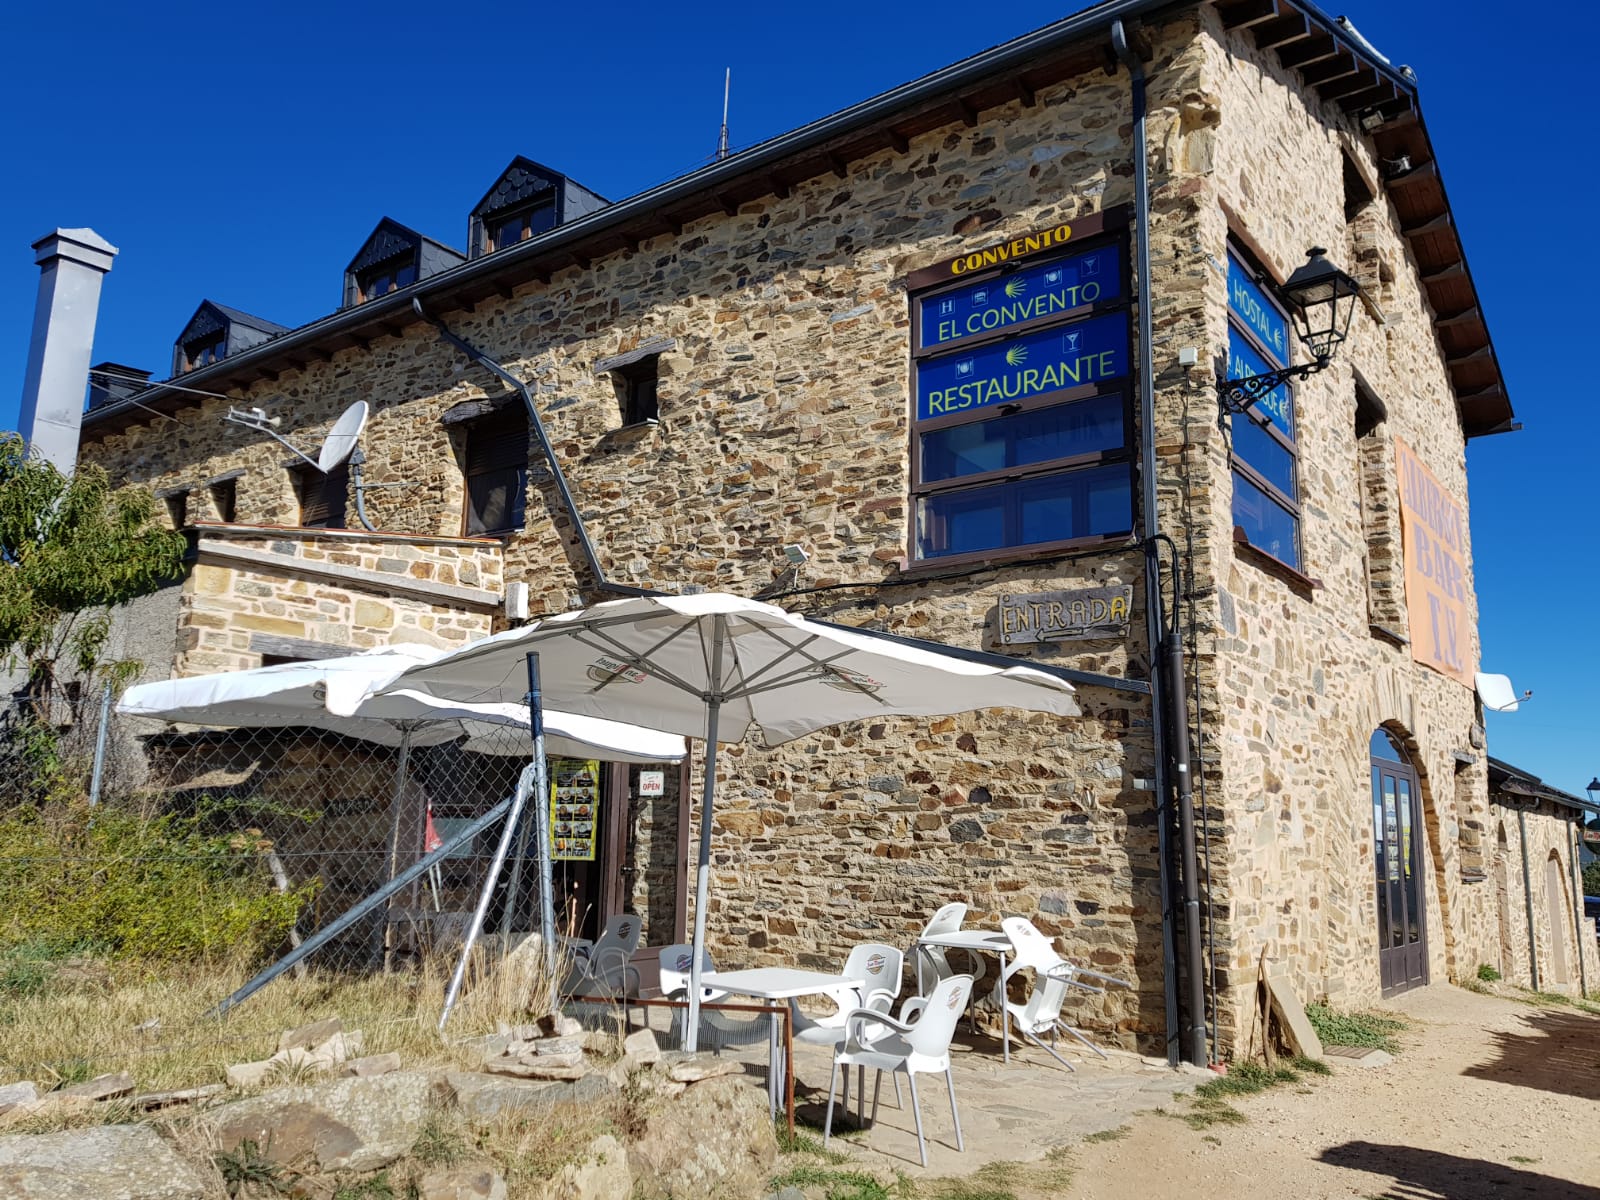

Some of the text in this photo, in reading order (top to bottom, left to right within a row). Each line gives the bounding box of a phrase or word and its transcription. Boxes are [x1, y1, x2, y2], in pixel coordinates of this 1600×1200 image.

[951, 225, 1072, 275] CONVENTO
[938, 281, 1100, 342] EL CONVENTO
[941, 299, 953, 314] H
[1234, 280, 1273, 343] HOSTAL
[928, 350, 1115, 415] RESTAURANTE
[1412, 521, 1464, 603] BAR
[1002, 595, 1128, 634] ENTRADA
[642, 782, 661, 791] OPEN
